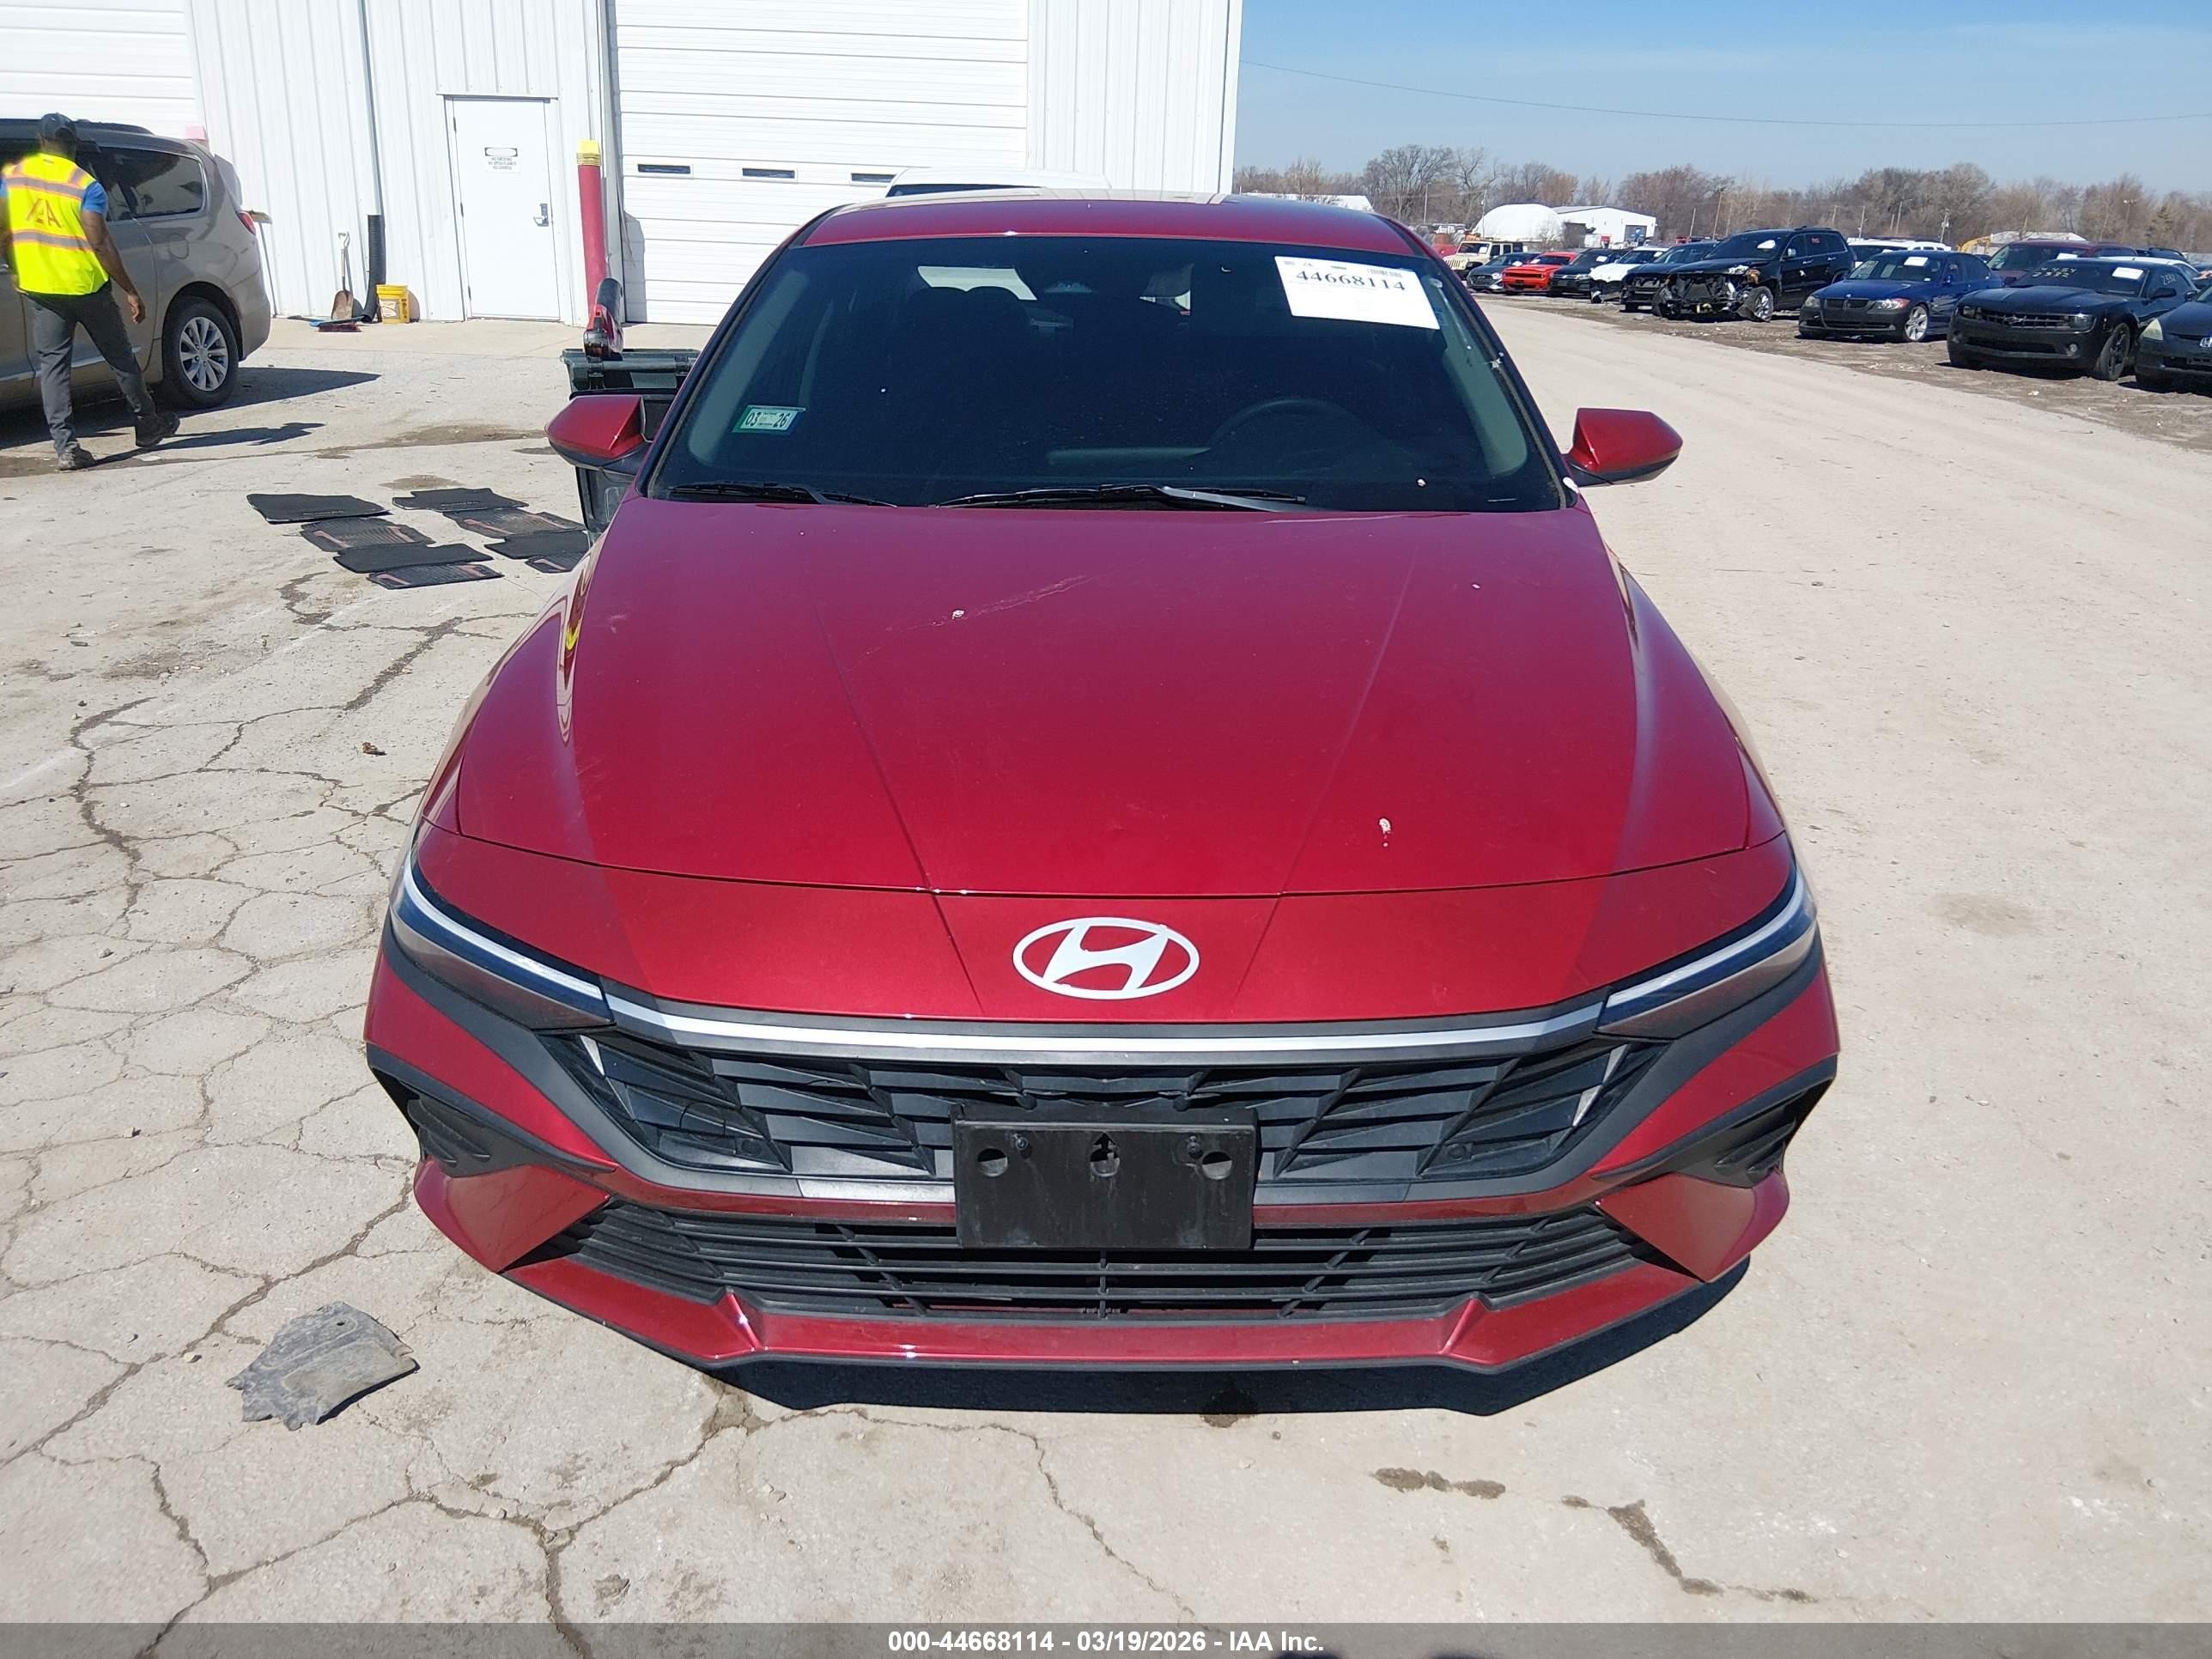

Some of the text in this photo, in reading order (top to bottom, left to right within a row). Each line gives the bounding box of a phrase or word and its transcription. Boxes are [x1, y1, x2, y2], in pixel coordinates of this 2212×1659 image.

[1296, 270, 1406, 291] 44668114
[744, 412, 790, 428] 03 26
